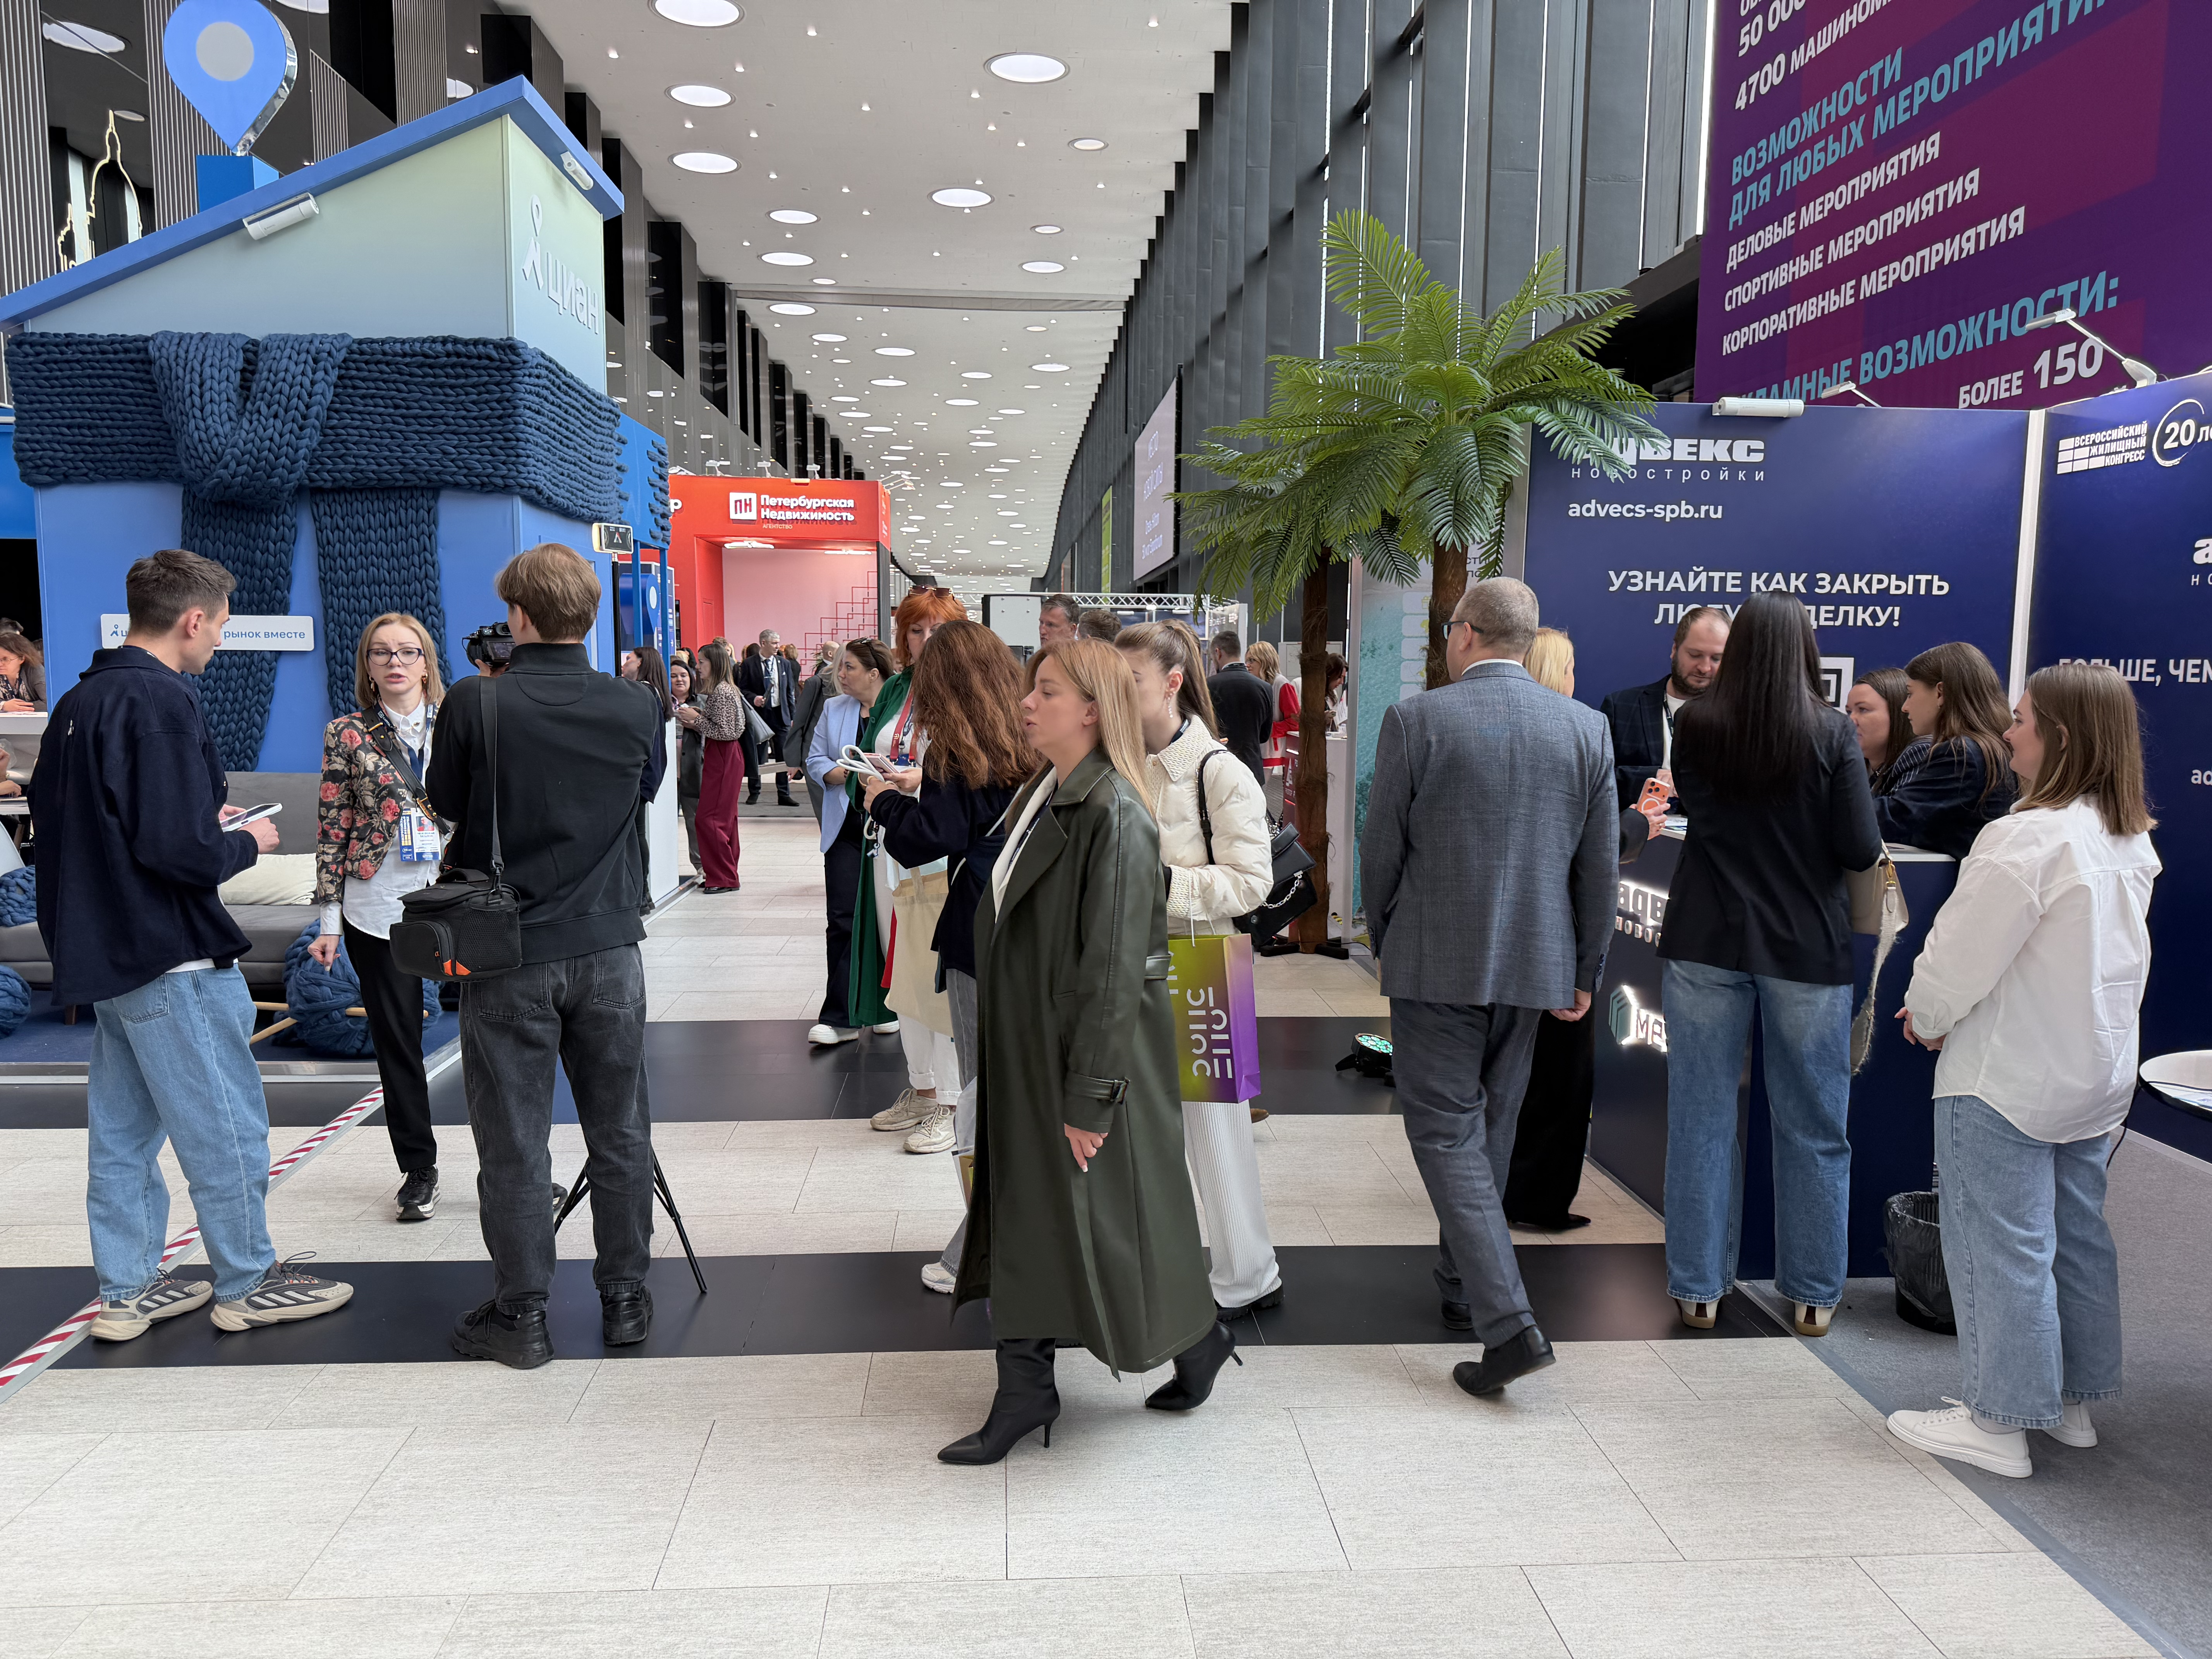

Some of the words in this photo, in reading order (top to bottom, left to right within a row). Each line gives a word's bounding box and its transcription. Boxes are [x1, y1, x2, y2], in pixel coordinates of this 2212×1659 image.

[1739, 15, 1763, 57] 50
[1735, 53, 1786, 110] 4700
[1790, 0, 1891, 74] МАШИНО
[1729, 173, 1771, 231] ДЛЯ
[1776, 114, 1865, 196] ЛЮБЫХ
[1872, 0, 2105, 139] МЕРОПРИЯТИ
[1732, 46, 1902, 186] ВОЗМОЖНОСТИ
[1726, 211, 1796, 274] ДЕЛОВЫЕ
[1799, 131, 1940, 230] МЕРОПРИЯТИЯ
[1725, 244, 1824, 311] СПОРТИВНЫЕ
[1827, 167, 1980, 264] МЕРОПРИЯТИЯ
[1723, 279, 1856, 356] КОРПОРАТИВНЫЕ
[1860, 206, 2025, 300] МЕРОПРИЯТИЯ
[1859, 271, 2119, 385] ВОЗМОЖНОСТИ:
[1959, 370, 2024, 409] БОЛЕЕ
[2034, 337, 2104, 389] 150
[2074, 420, 2148, 447] ВСЕРОССИЙСКИЙ
[2090, 434, 2147, 456] ЖИЛИЩНЫЙ
[2164, 419, 2195, 449] 20
[2105, 449, 2145, 466] КОНГРЕСС
[761, 495, 854, 509] Петербургская
[761, 508, 855, 521] Недвижимость
[1568, 499, 1723, 522] advecs-spb.ru
[1608, 566, 1742, 592] УЗНАЙТЕ
[1751, 573, 1807, 593] КАК
[1815, 573, 1950, 596] ЗАКРЫТЬ
[1806, 605, 1900, 630] ДЕЛКУ!
[224, 630, 261, 639] рынок
[263, 630, 305, 639] вместе
